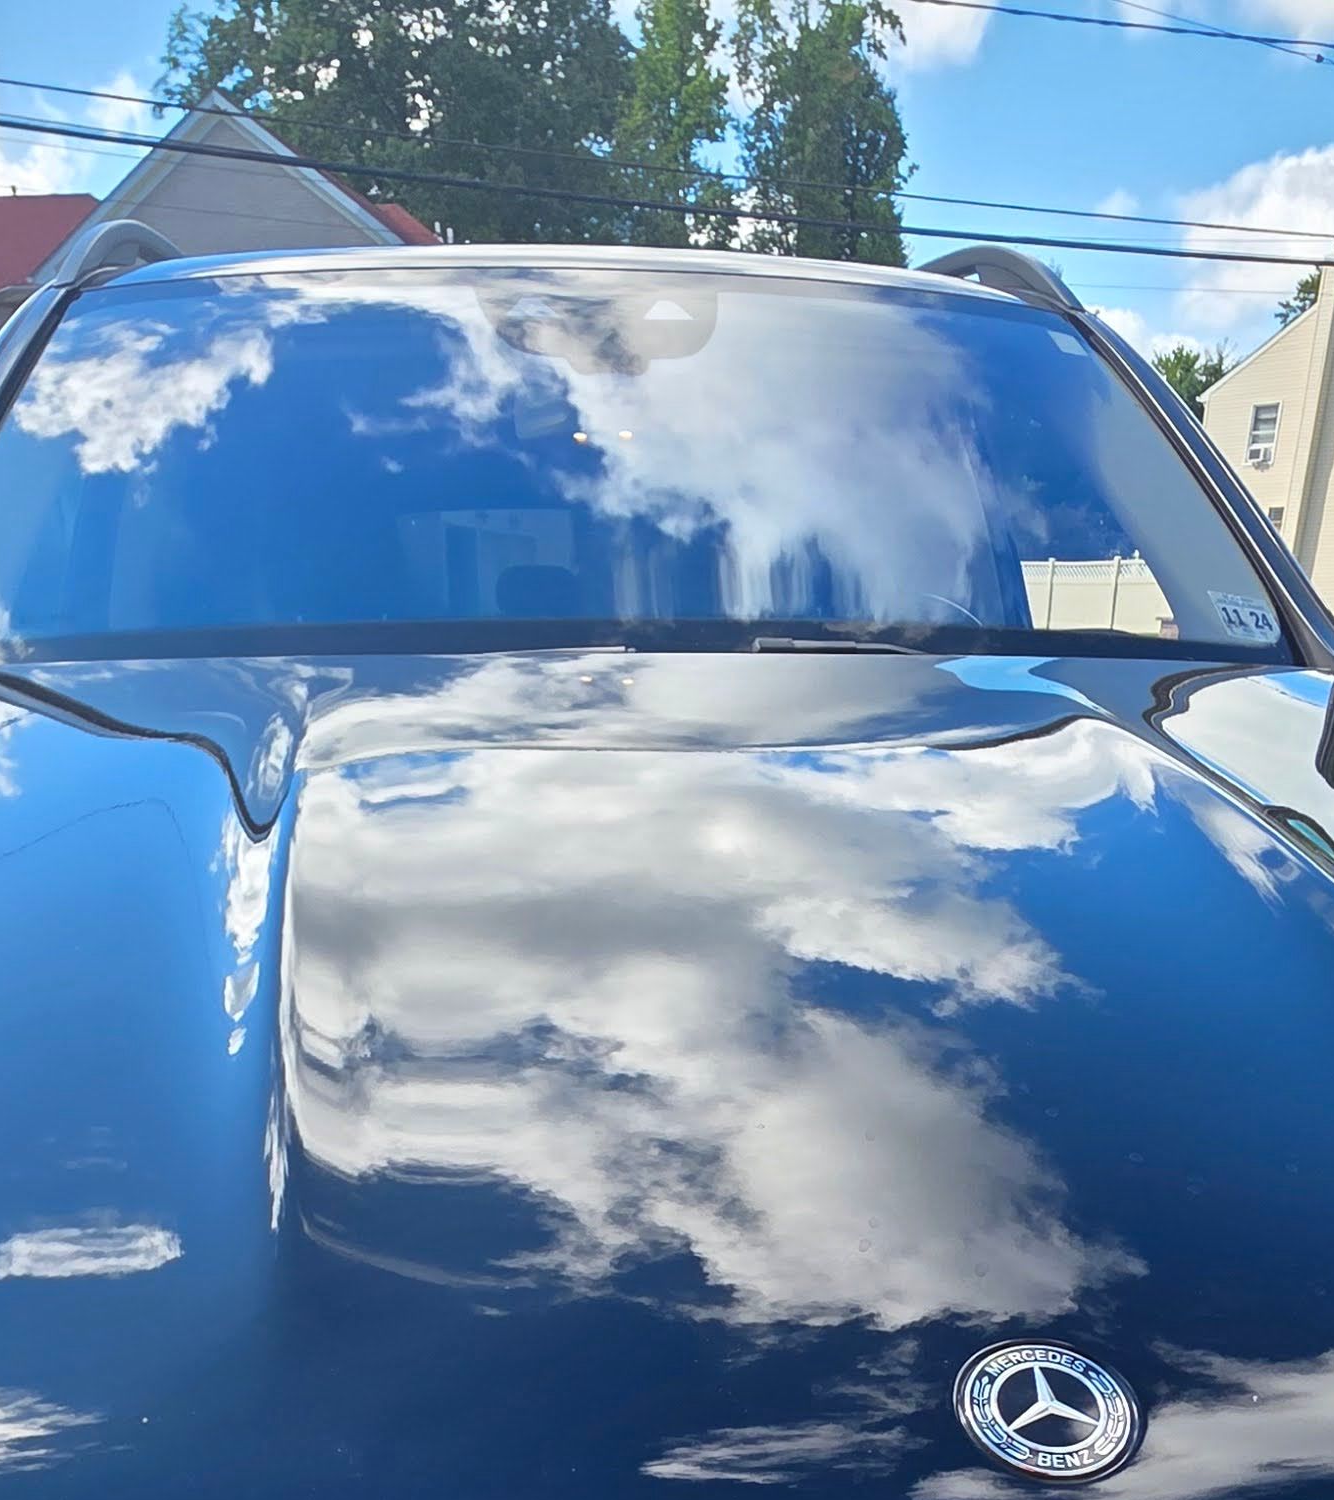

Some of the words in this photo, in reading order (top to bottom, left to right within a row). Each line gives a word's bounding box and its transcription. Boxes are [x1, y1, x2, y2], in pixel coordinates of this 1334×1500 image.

[1221, 606, 1248, 627] 11
[1249, 611, 1273, 631] 24
[984, 1349, 1086, 1377] MERCEDES
[1037, 1449, 1095, 1468] BENZ
